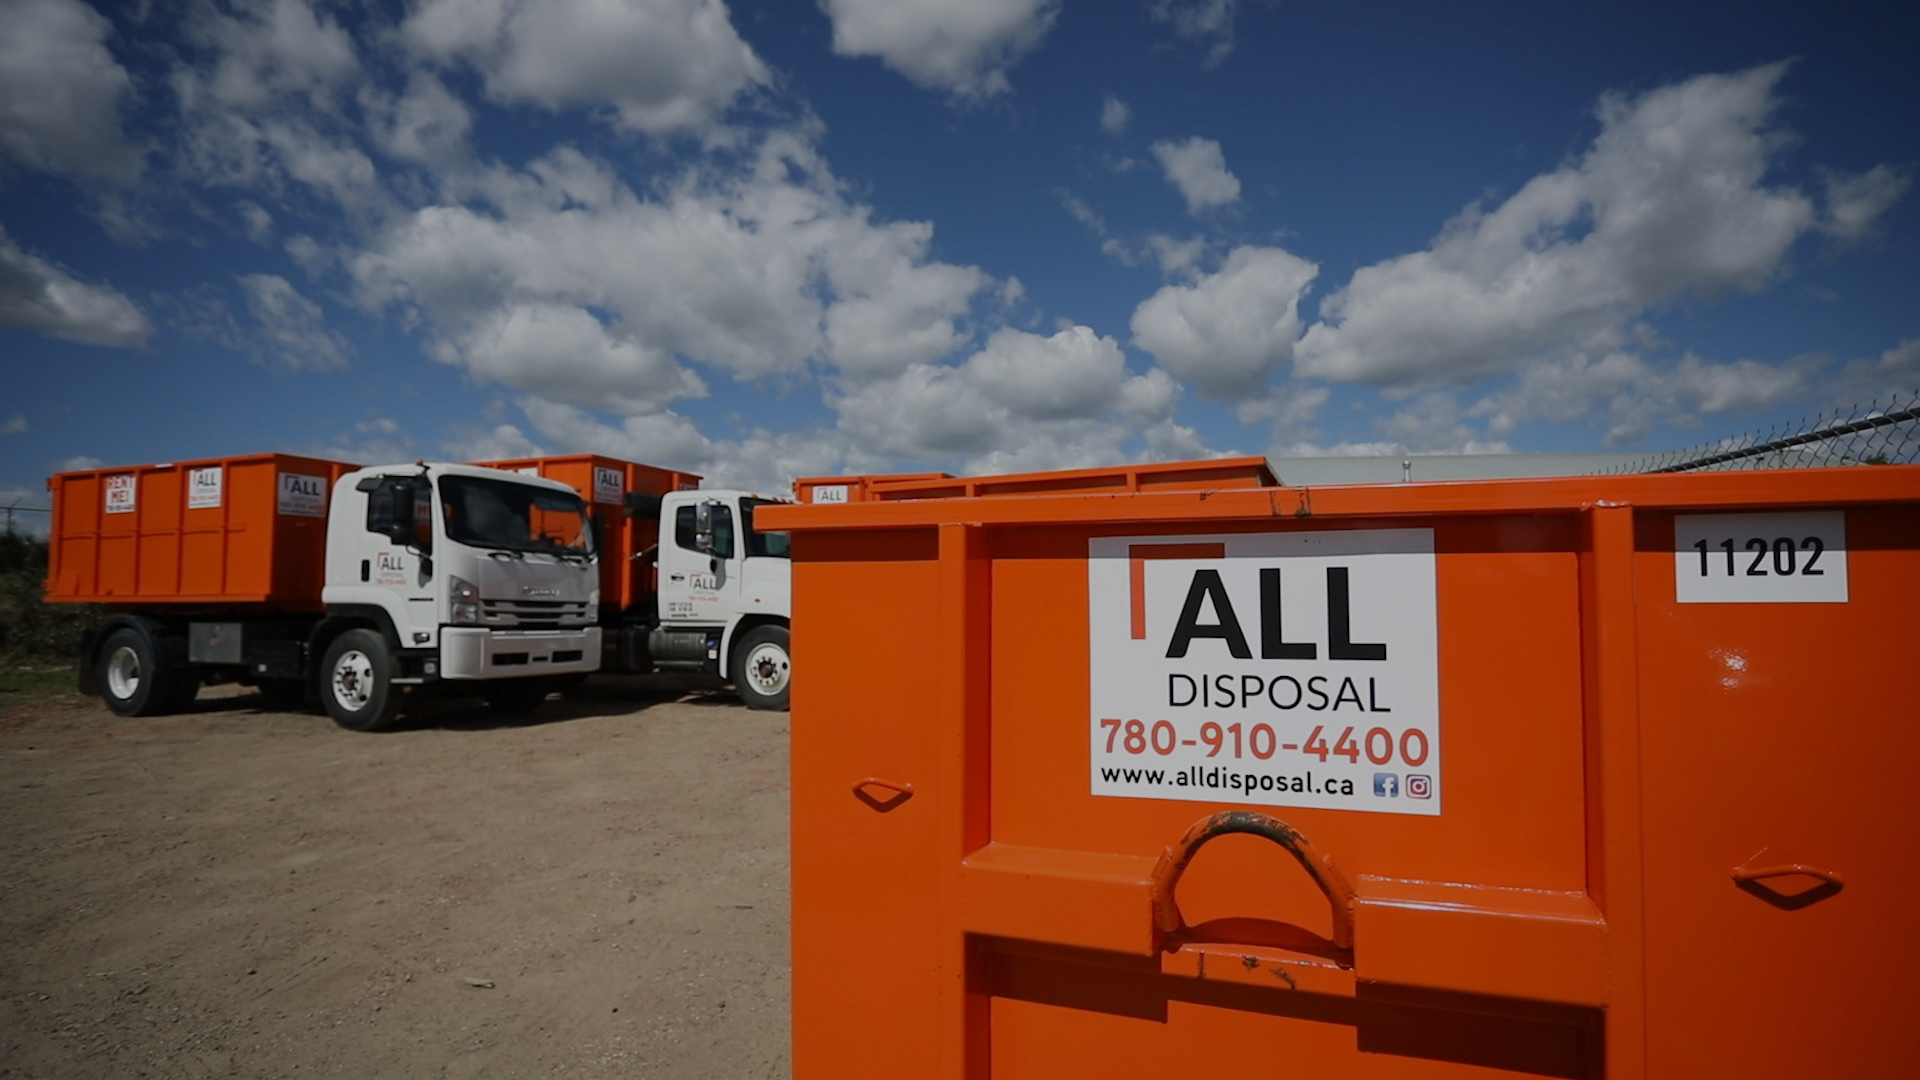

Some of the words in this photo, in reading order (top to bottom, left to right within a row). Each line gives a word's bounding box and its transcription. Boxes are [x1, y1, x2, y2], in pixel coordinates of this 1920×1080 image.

[196, 472, 217, 487] ALL
[600, 472, 620, 487] ALL
[290, 480, 321, 496] ALL
[820, 490, 842, 501] ALL
[380, 556, 404, 571] ALL
[1693, 536, 1825, 577] 11202
[693, 577, 718, 590] ALL
[1165, 566, 1387, 661] ALL
[1168, 673, 1391, 713] DISPOSAL
[1100, 718, 1430, 767] 780-910-4400
[1101, 766, 1354, 796] www.alldisposal.ca
